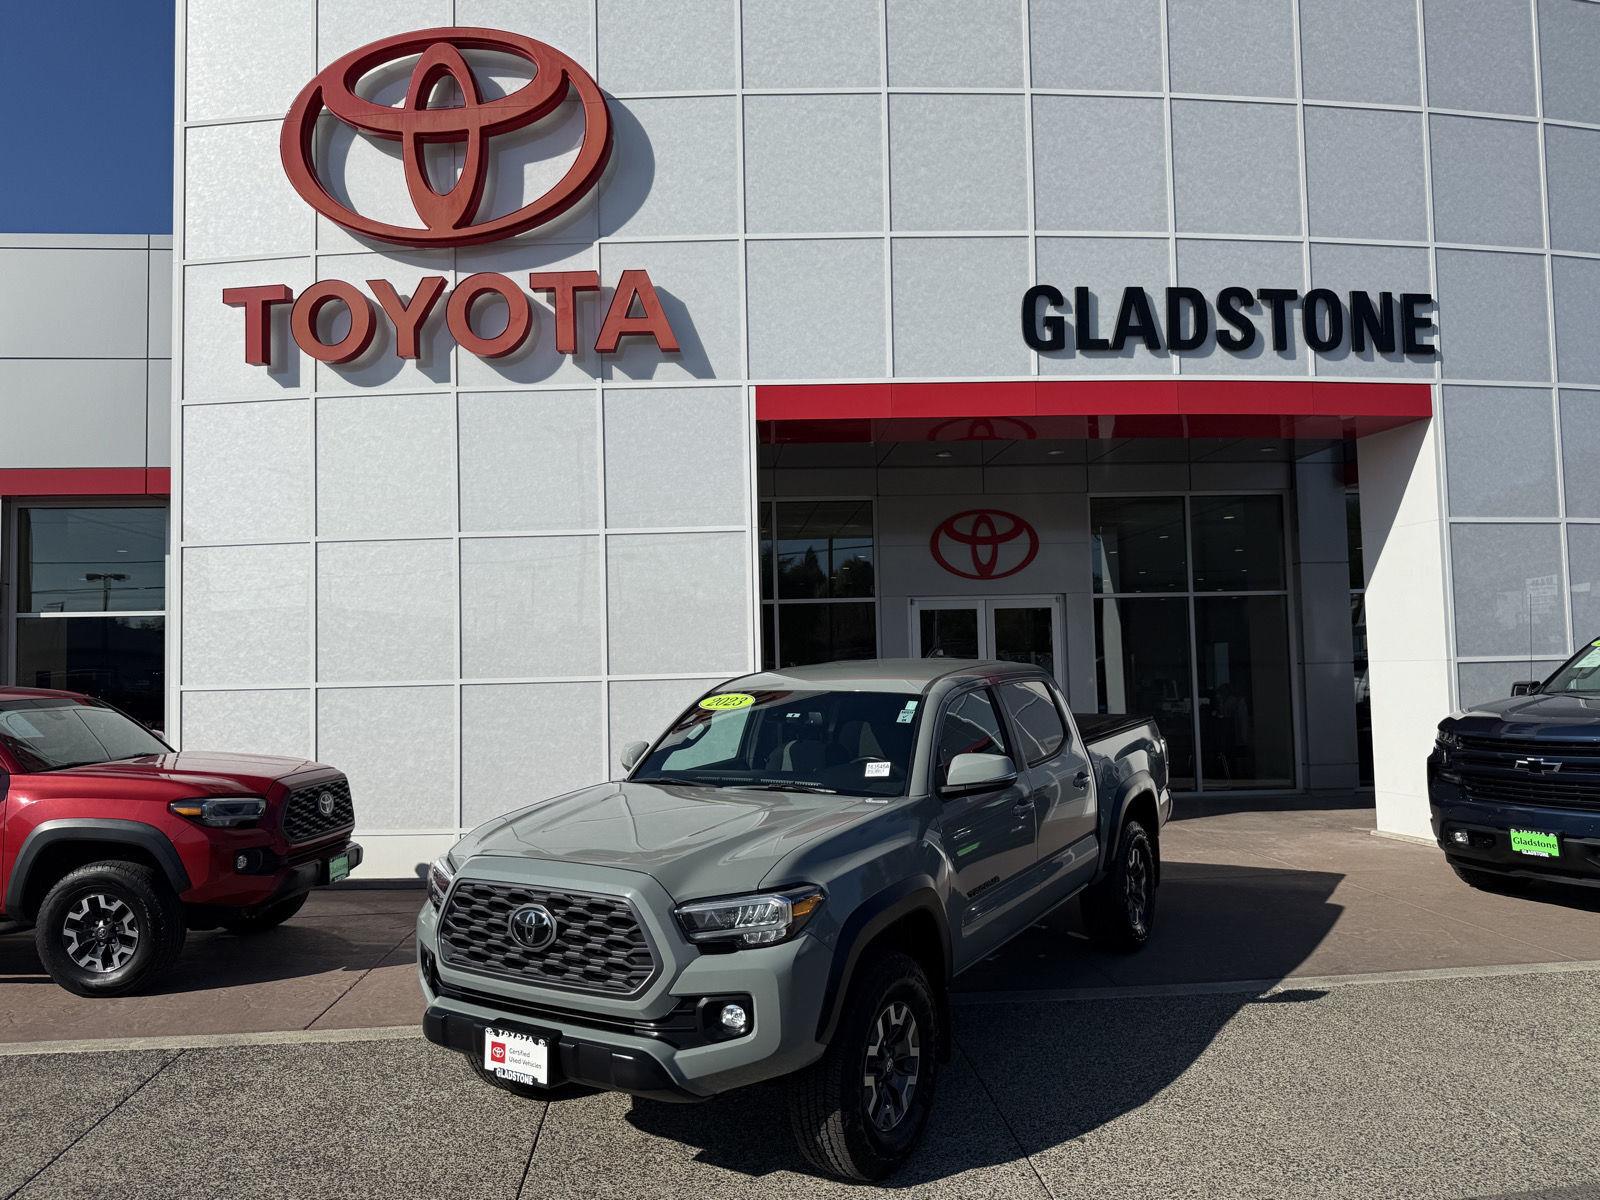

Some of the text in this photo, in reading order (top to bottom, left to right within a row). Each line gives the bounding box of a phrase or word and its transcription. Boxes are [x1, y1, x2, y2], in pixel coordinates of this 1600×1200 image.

[222, 269, 681, 367] TOYOTA
[1021, 284, 1438, 355] GLADSTONE
[705, 696, 748, 706] 2023
[1512, 836, 1557, 849] Gladstone
[498, 1029, 533, 1043] TOYOTA
[508, 1047, 530, 1058] Certified
[508, 1056, 542, 1069] Used Vehicles
[496, 1067, 533, 1085] GLADSTONE
